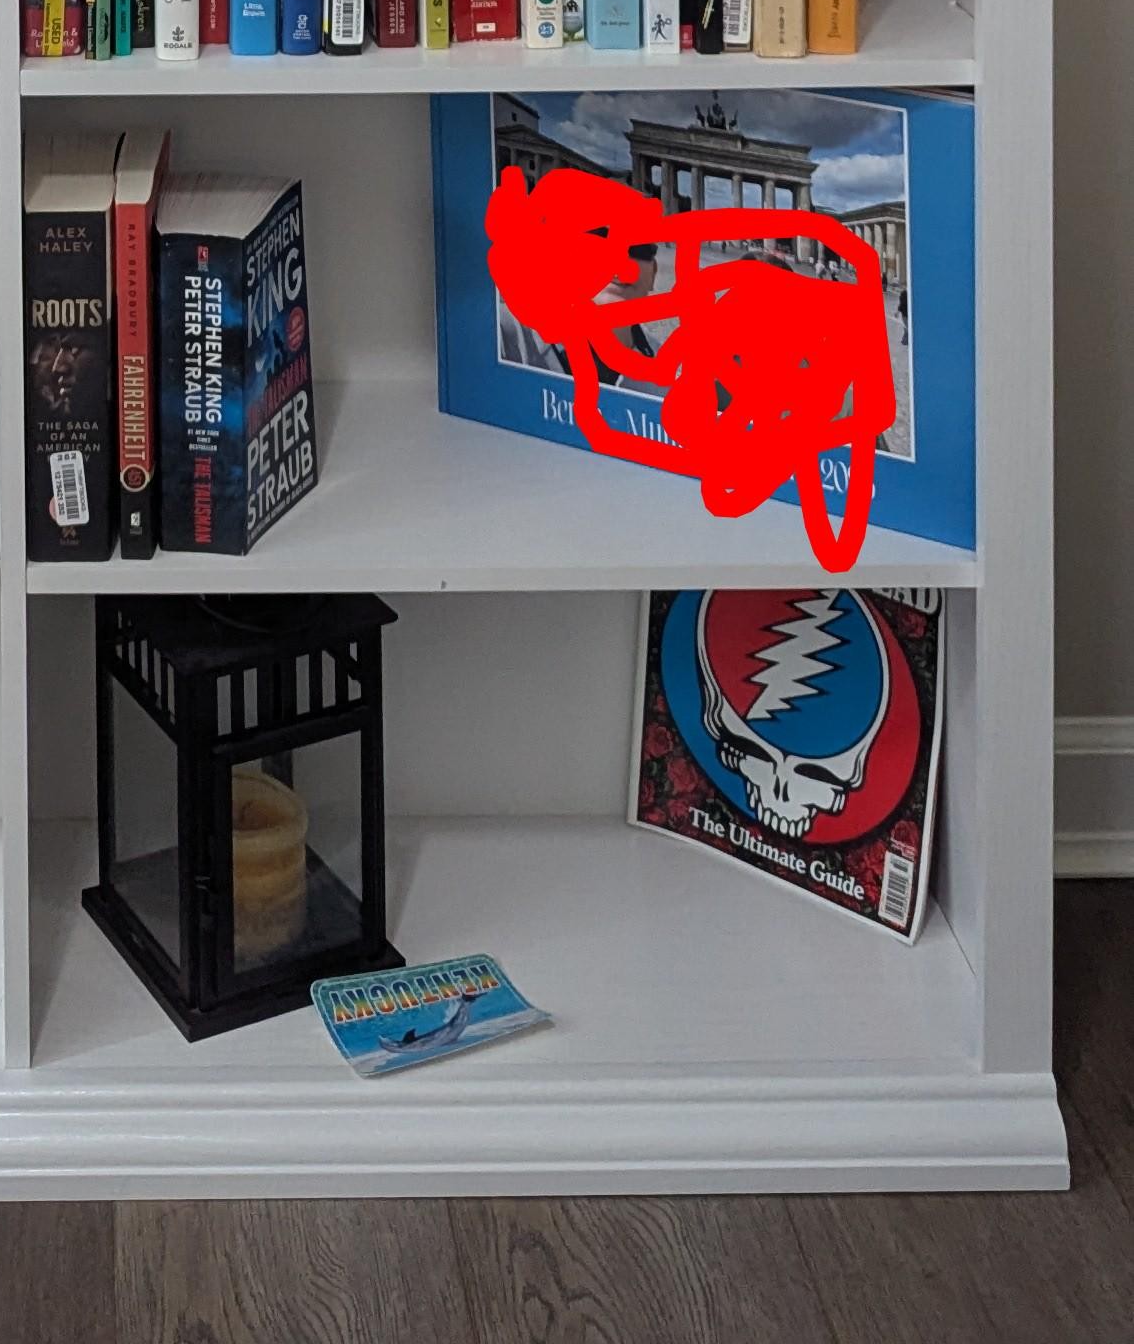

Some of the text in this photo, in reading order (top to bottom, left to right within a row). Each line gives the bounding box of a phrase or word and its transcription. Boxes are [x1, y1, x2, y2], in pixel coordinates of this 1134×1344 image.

[39, 241, 93, 253] HALEY
[46, 227, 87, 238] ALEX
[33, 299, 103, 328] ROOTS
[185, 275, 202, 424] PETER STRAUB
[205, 277, 222, 424] STEPHEN KING
[122, 355, 145, 462] FAHRENHEIT
[688, 806, 865, 900] The Ultimate Guide
[333, 964, 500, 1022] KENTUCKY
